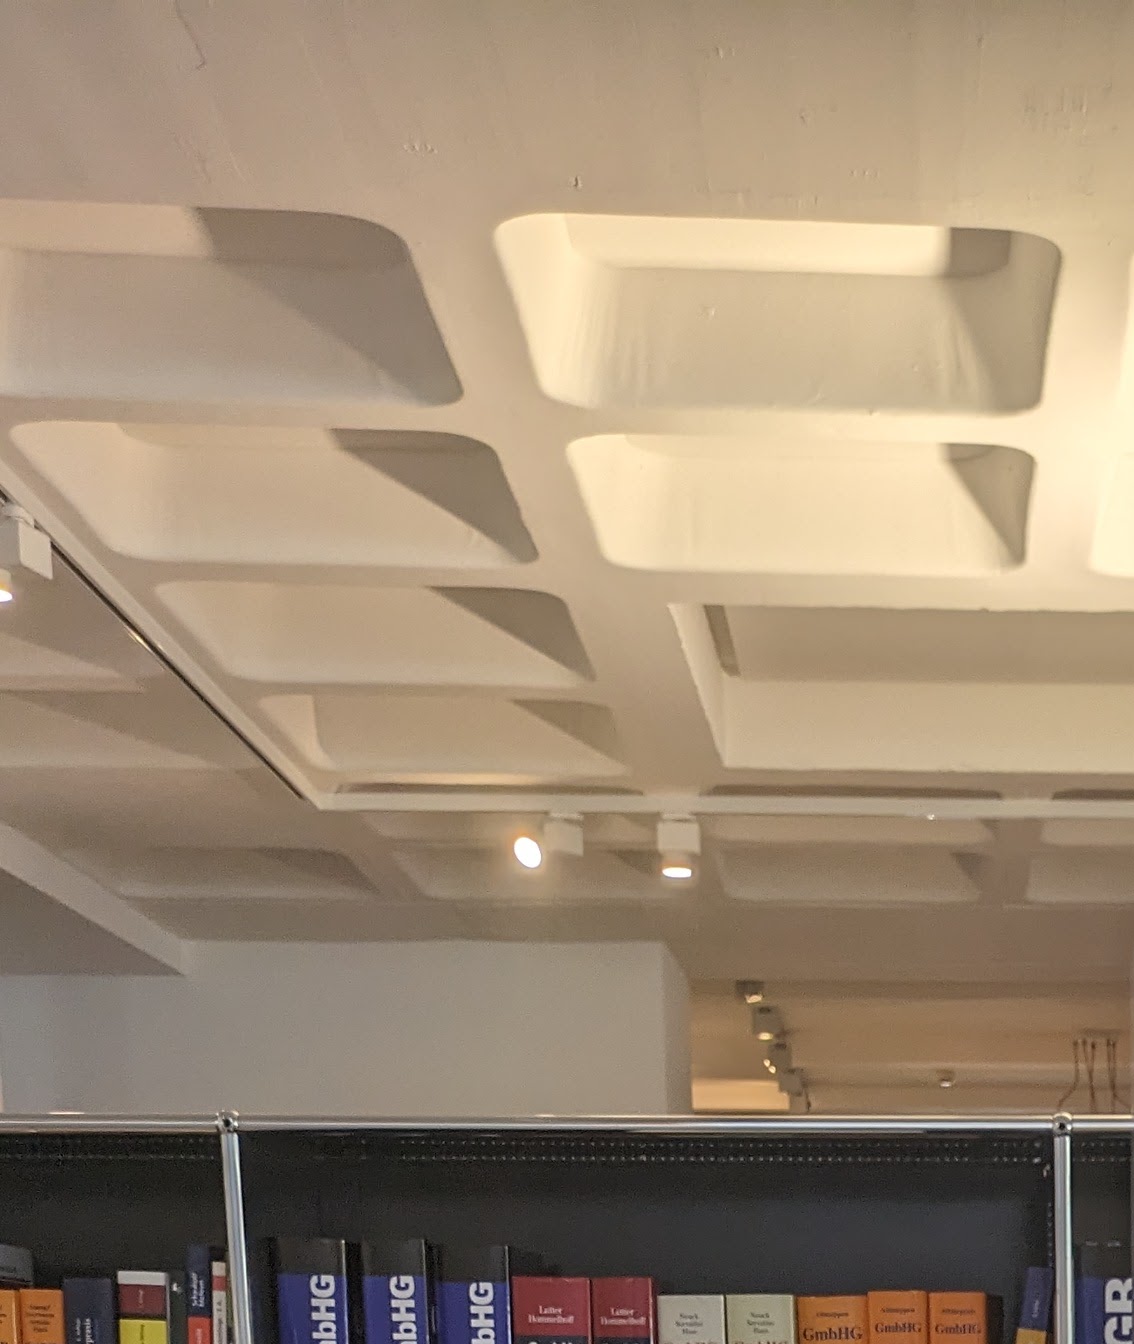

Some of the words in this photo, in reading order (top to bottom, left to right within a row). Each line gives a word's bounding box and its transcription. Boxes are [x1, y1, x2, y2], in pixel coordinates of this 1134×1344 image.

[803, 1327, 863, 1341] GmbHG
[874, 1323, 922, 1335] GmbHG
[935, 1323, 982, 1335] GmbHG
